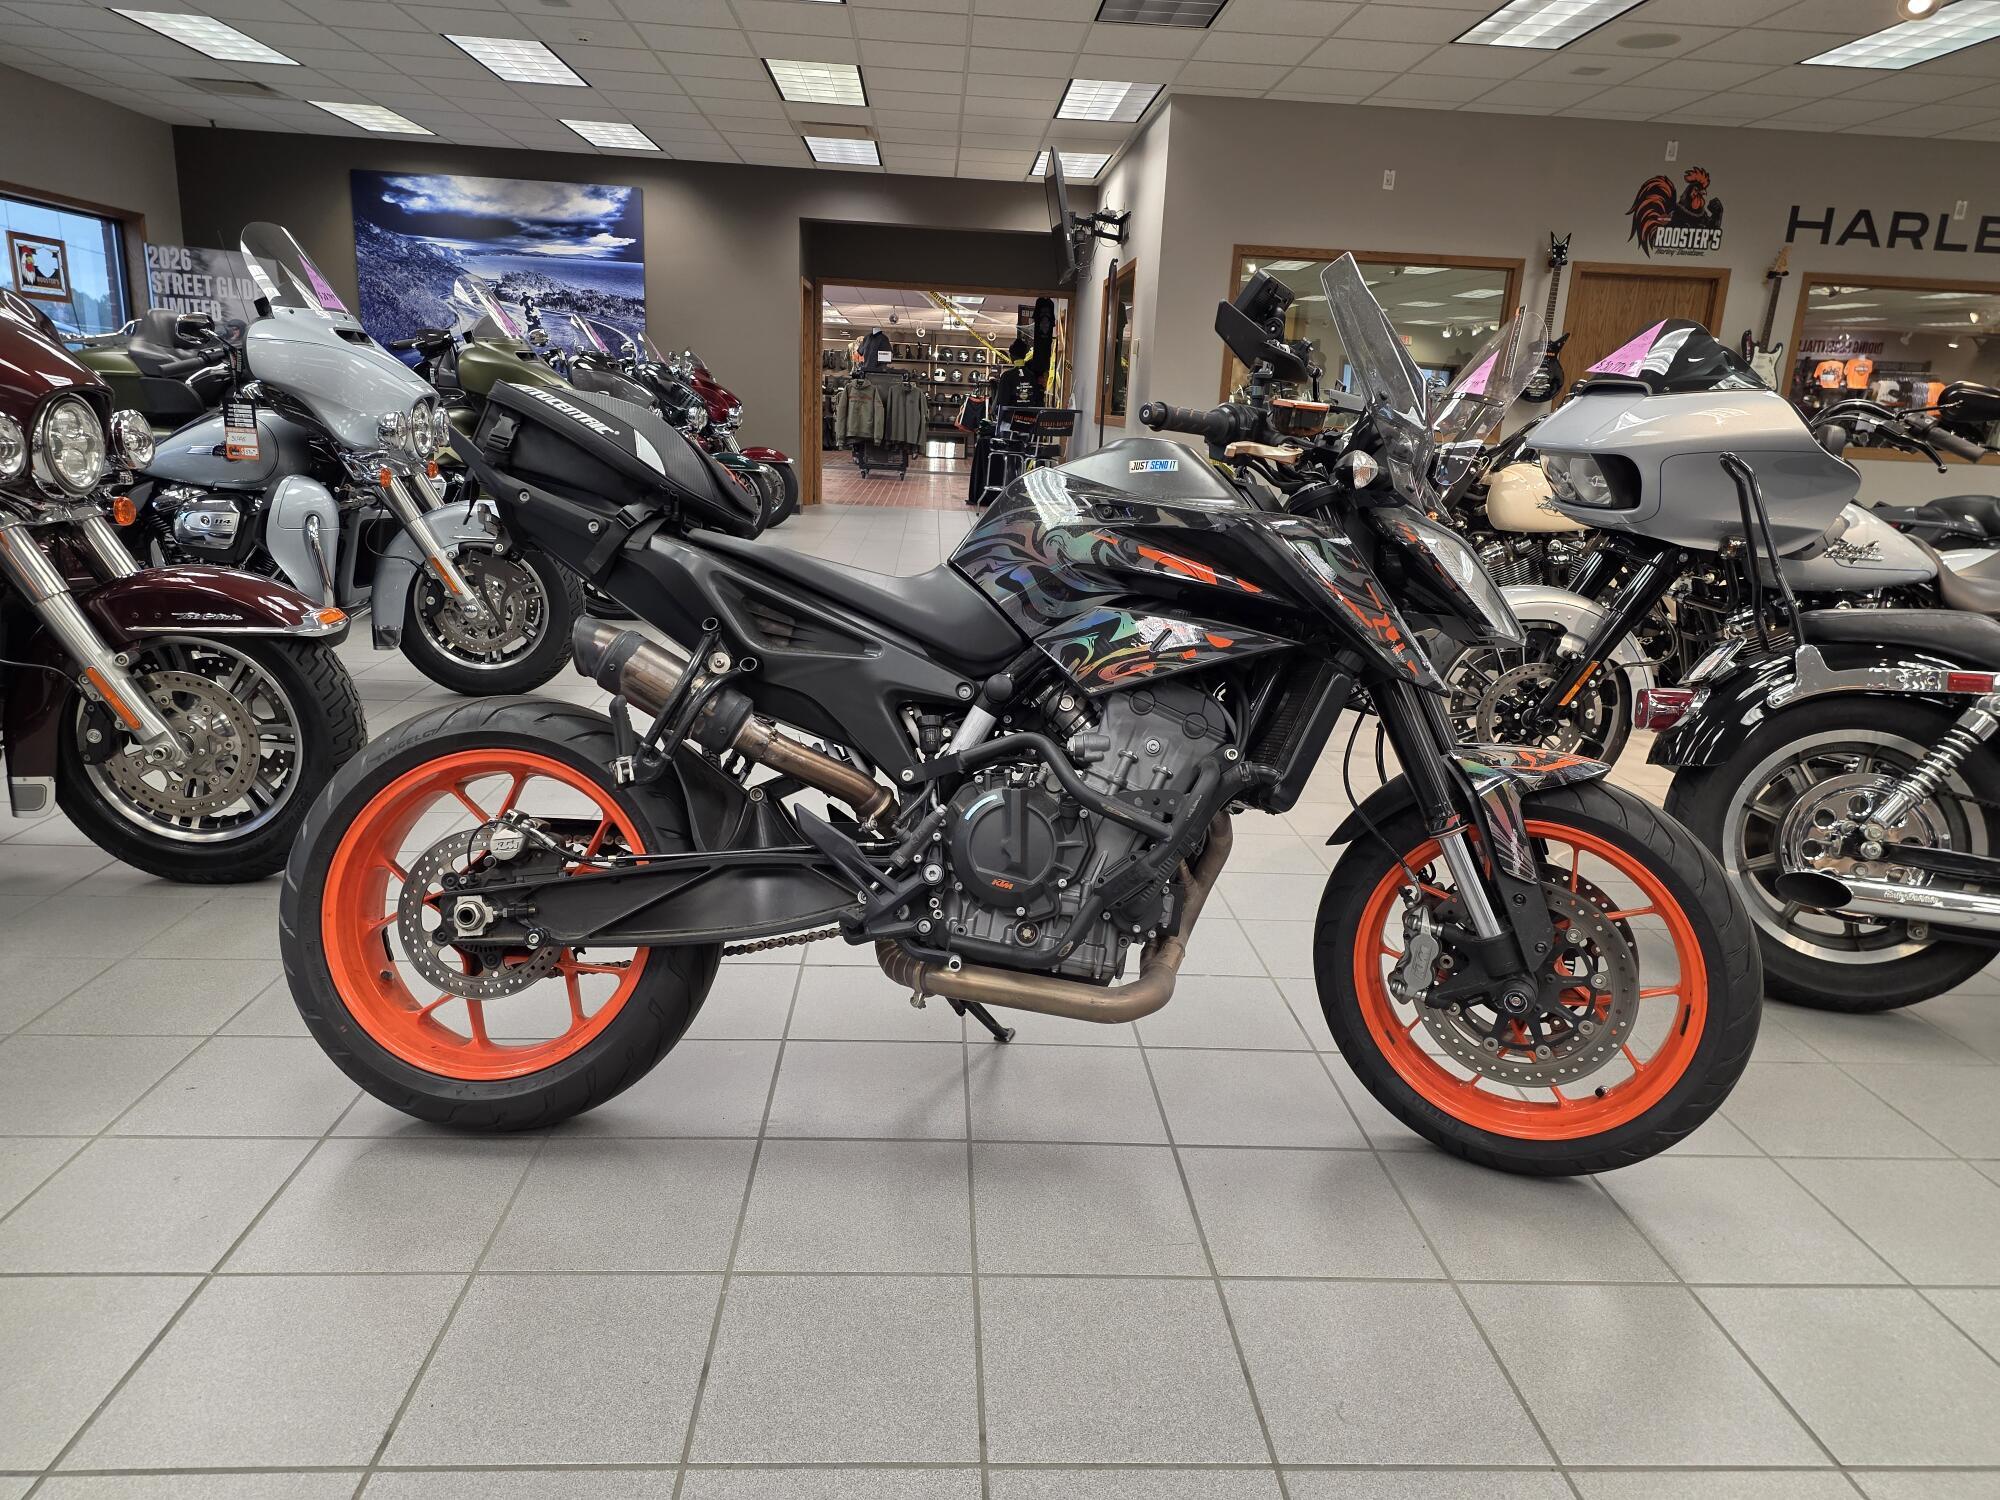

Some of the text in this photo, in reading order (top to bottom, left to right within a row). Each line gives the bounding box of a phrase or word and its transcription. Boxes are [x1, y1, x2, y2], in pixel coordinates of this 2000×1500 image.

[1655, 226, 1722, 250] ROOSTER'S
[1785, 205, 2000, 253] HARLE
[148, 245, 192, 271] 2026
[150, 271, 213, 297] STREET
[1131, 460, 1177, 471] JUST SEND IT
[991, 878, 1014, 890] KTM
